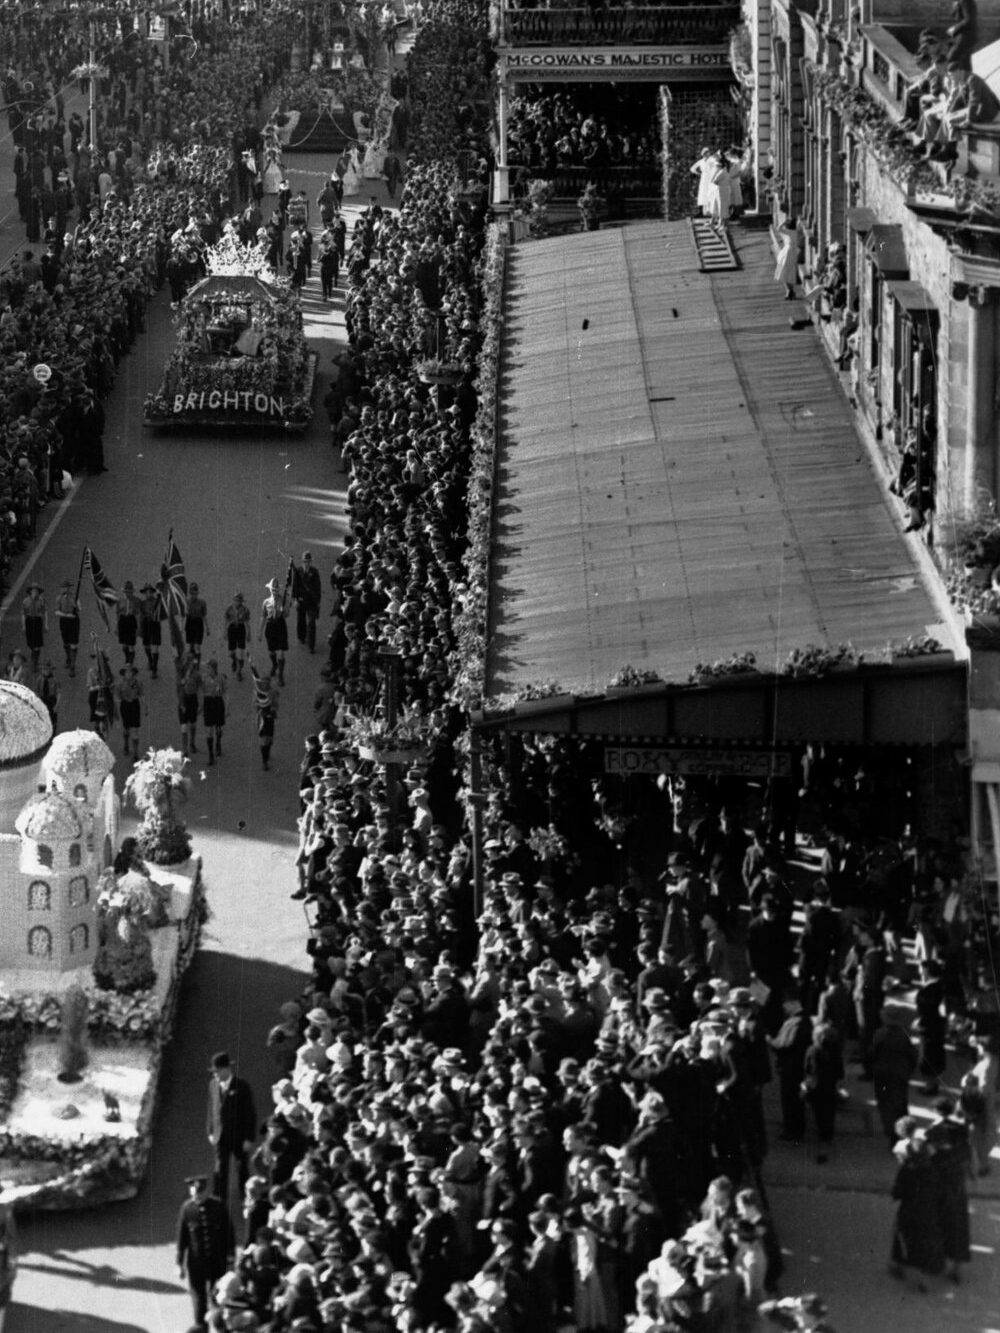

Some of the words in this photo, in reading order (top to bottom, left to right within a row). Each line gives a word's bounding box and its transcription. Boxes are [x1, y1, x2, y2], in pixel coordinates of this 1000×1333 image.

[611, 53, 684, 66] MAJESTIC
[690, 53, 729, 65] HOTE
[174, 390, 284, 416] BRIGHTON
[606, 750, 679, 770] ROXY
